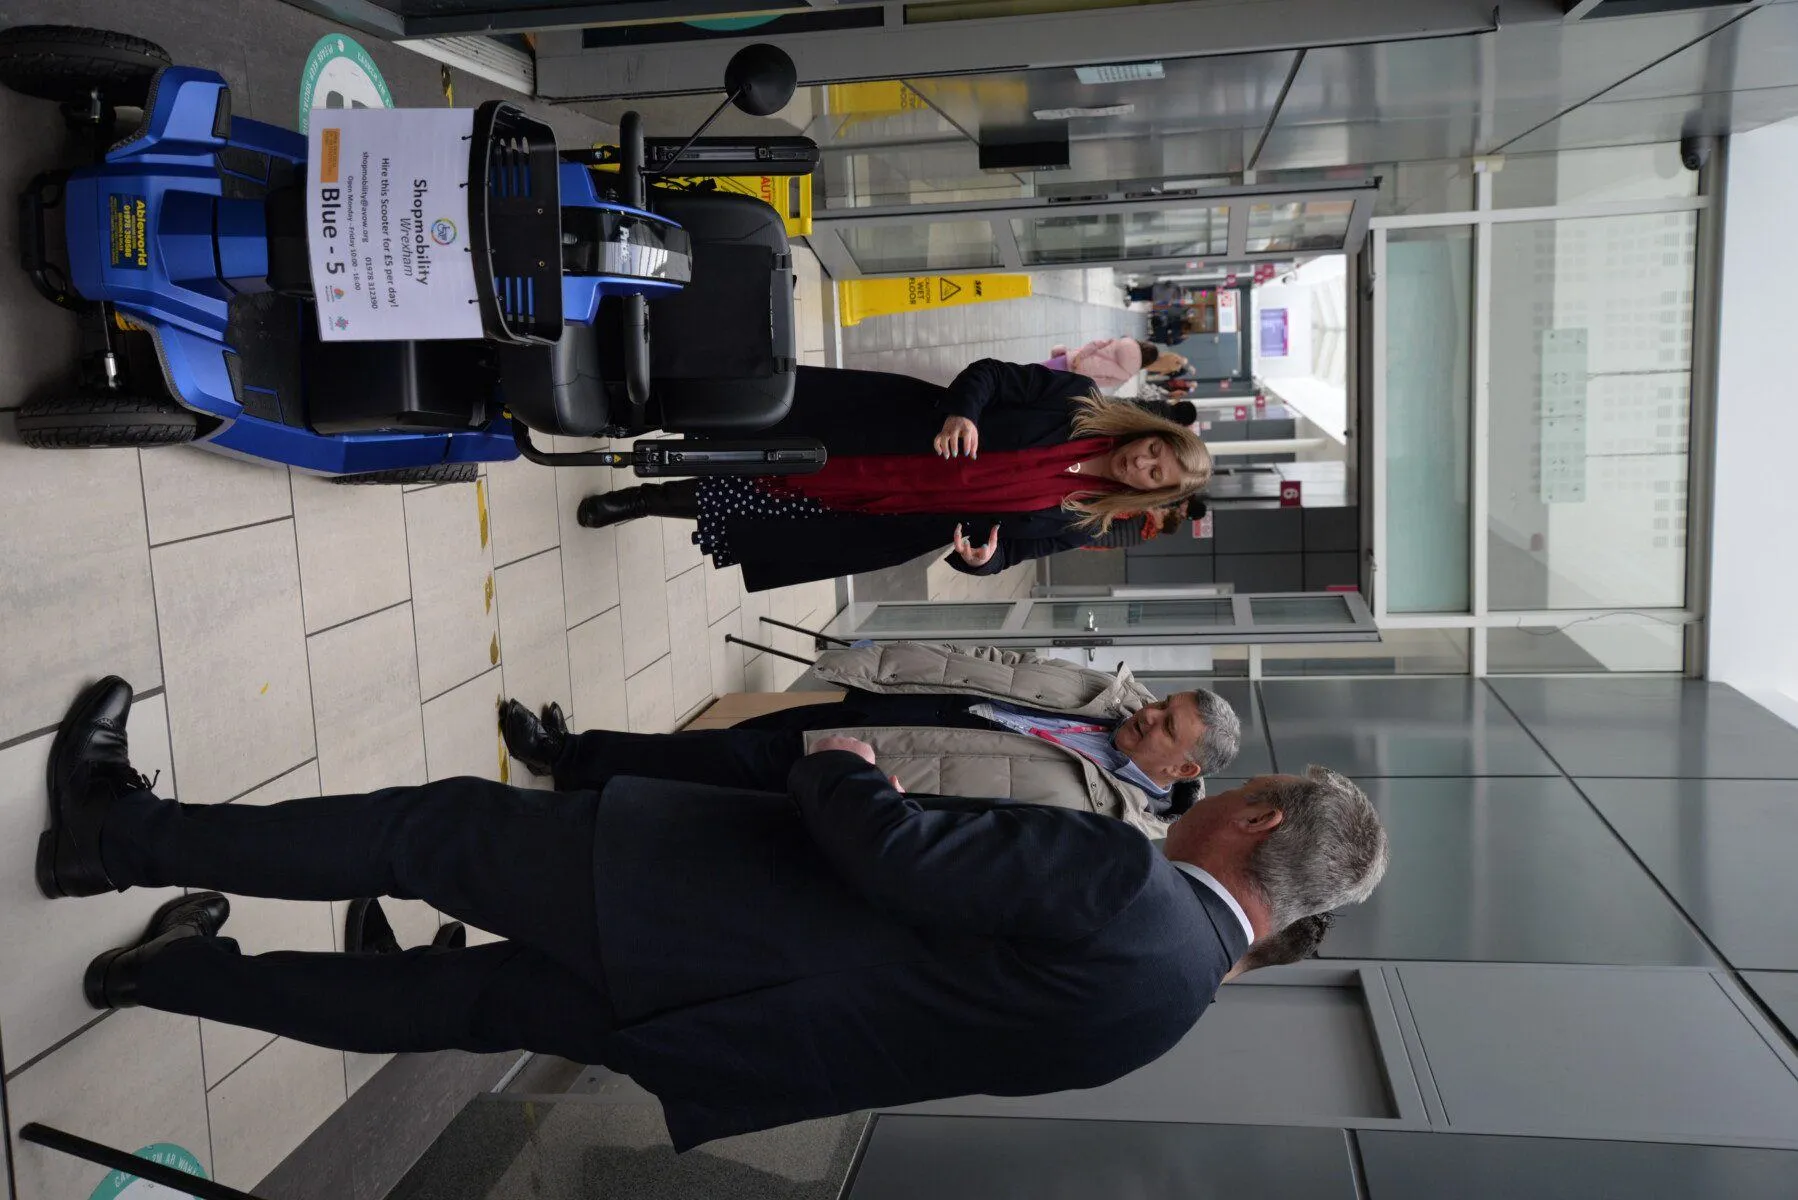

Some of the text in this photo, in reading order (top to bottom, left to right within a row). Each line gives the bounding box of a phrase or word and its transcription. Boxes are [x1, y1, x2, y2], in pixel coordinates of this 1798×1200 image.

[309, 60, 318, 80] KEEP
[317, 43, 334, 63] PLEASE
[302, 80, 312, 113] SOCIAL
[346, 176, 354, 194] Open
[360, 151, 370, 243] shopmobility@avow.org
[322, 188, 341, 238] Blue
[346, 194, 354, 222] Monday
[136, 200, 147, 266] Ableworld
[348, 227, 356, 248] Friday
[380, 158, 399, 308] Hire this Scooter for £5 per day!
[400, 218, 413, 276] Wrexham
[410, 178, 432, 286] Shopmobility
[619, 226, 630, 262] Pride
[326, 262, 345, 275] 5
[364, 257, 378, 309] 01978 312390
[1283, 488, 1298, 499] 6
